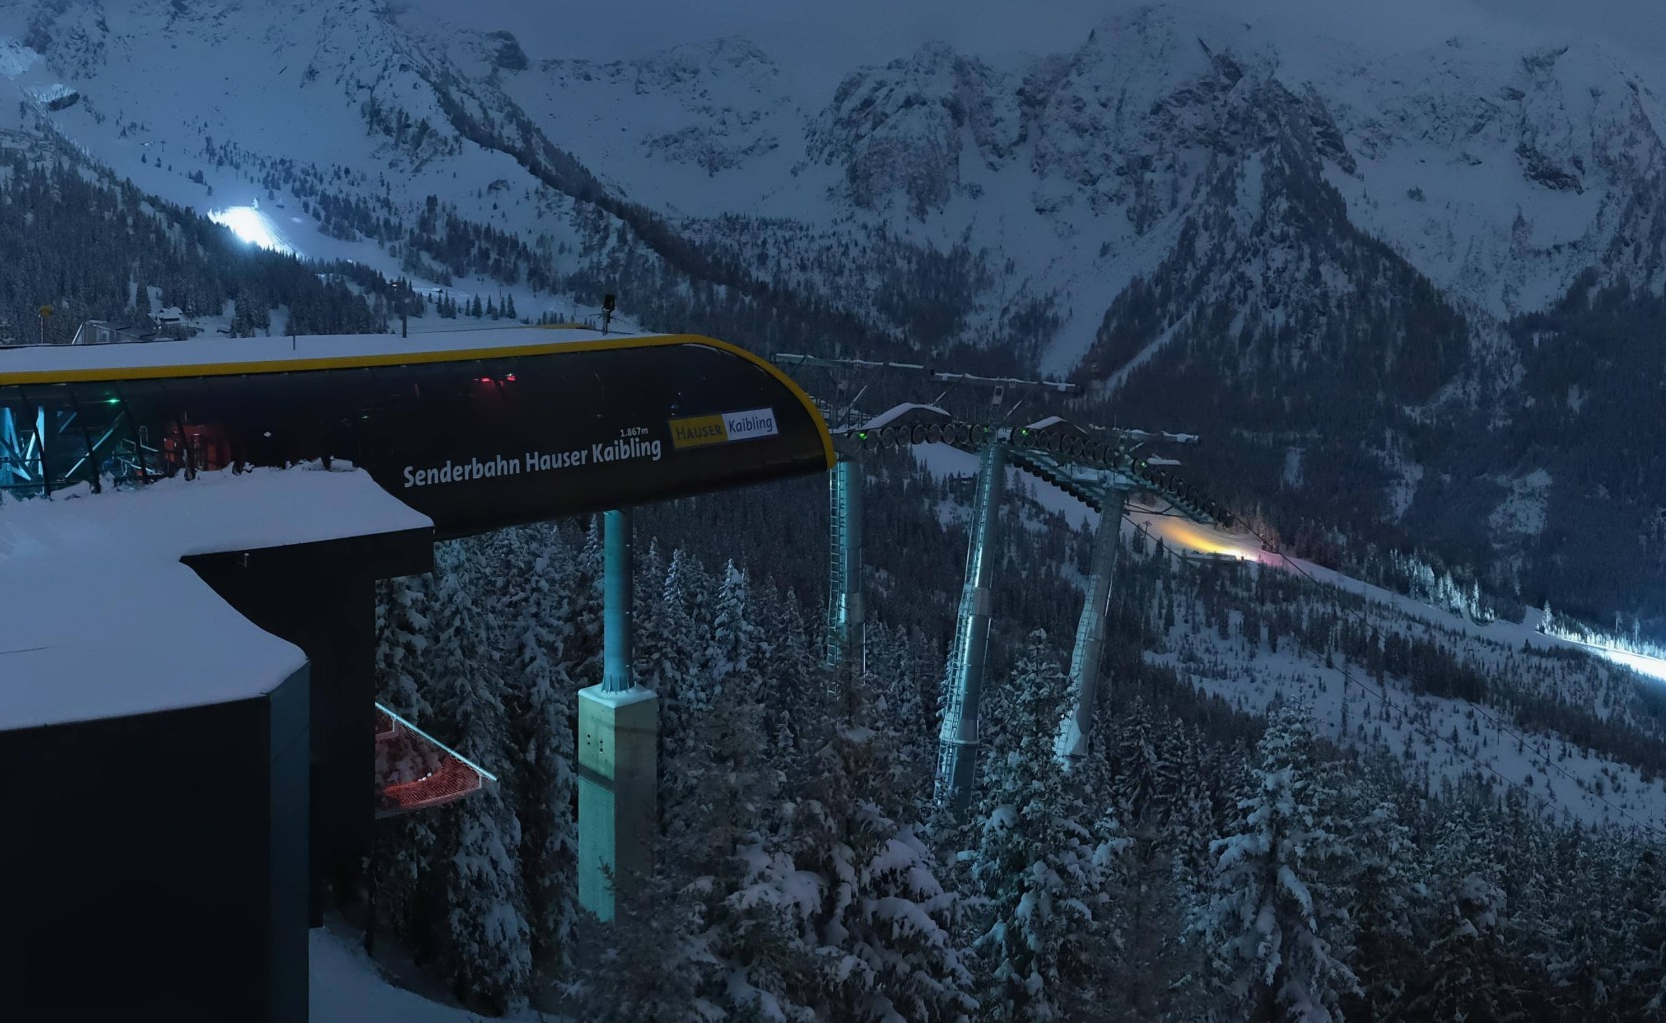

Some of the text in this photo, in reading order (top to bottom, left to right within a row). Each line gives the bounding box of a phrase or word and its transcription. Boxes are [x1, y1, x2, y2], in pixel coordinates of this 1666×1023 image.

[620, 427, 649, 438] 1.867m
[676, 416, 773, 440] HAUSER Kaibling
[403, 437, 663, 488] Senderbahn Hauser Kaibling
